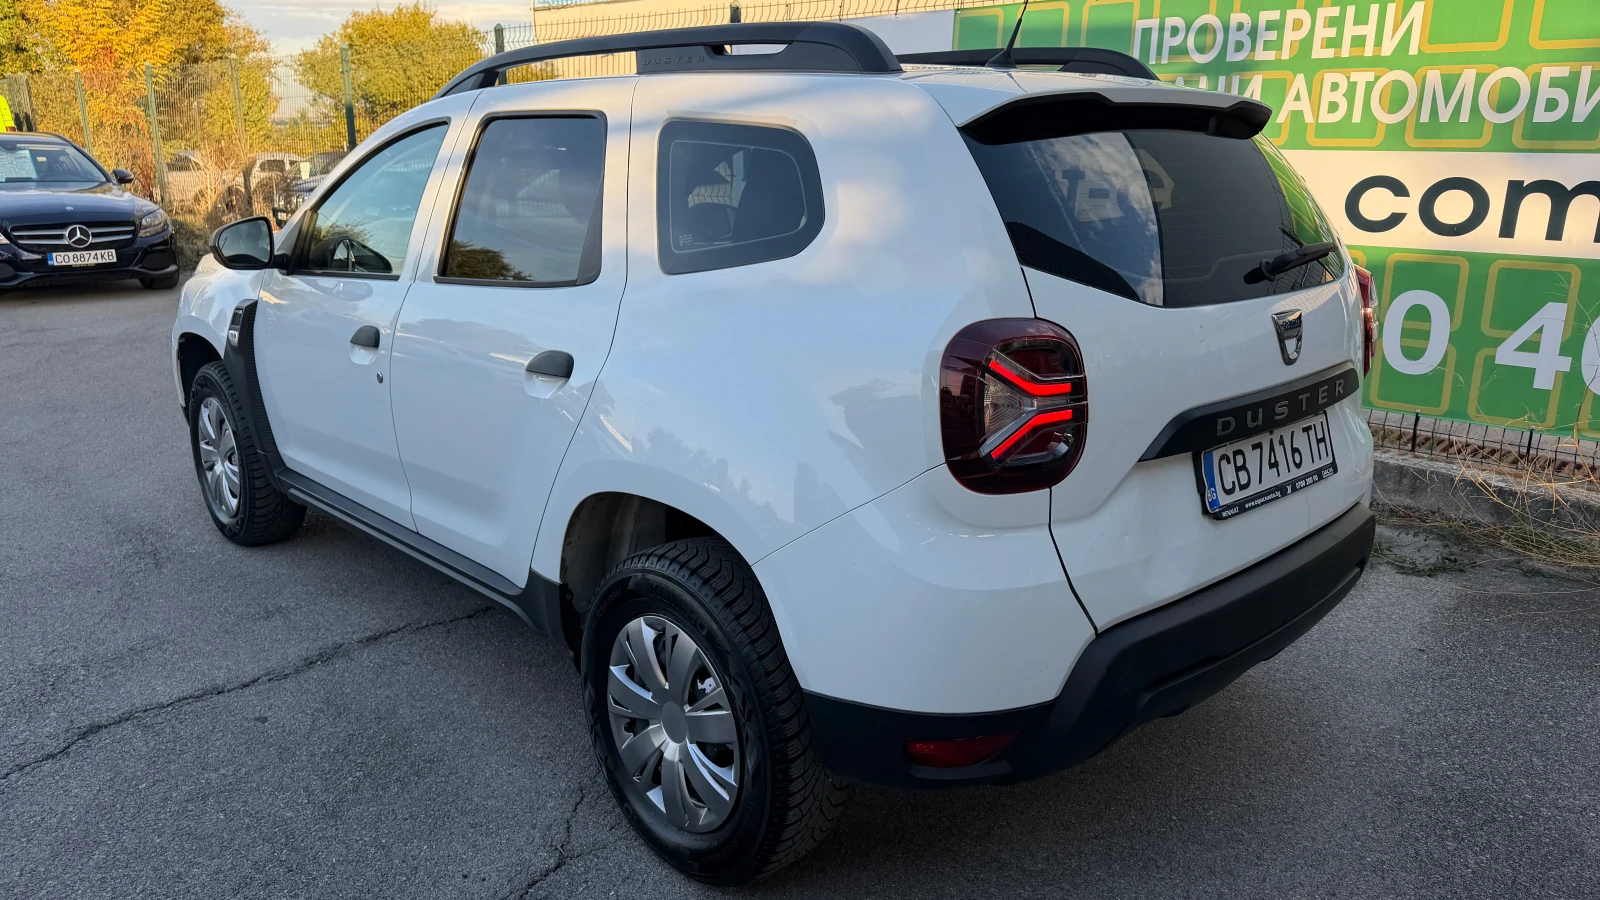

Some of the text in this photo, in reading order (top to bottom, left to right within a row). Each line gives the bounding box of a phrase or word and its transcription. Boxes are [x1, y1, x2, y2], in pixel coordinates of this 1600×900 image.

[642, 55, 705, 66] DUSTER
[1132, 0, 1425, 65] ПРОВЕРЕНИ
[1344, 175, 1600, 242] com
[72, 251, 99, 263] 8874
[101, 250, 115, 261] KB
[1494, 301, 1600, 395] 4
[1216, 378, 1345, 437] DUSTER
[1218, 420, 1329, 495] CB 7416 TH
